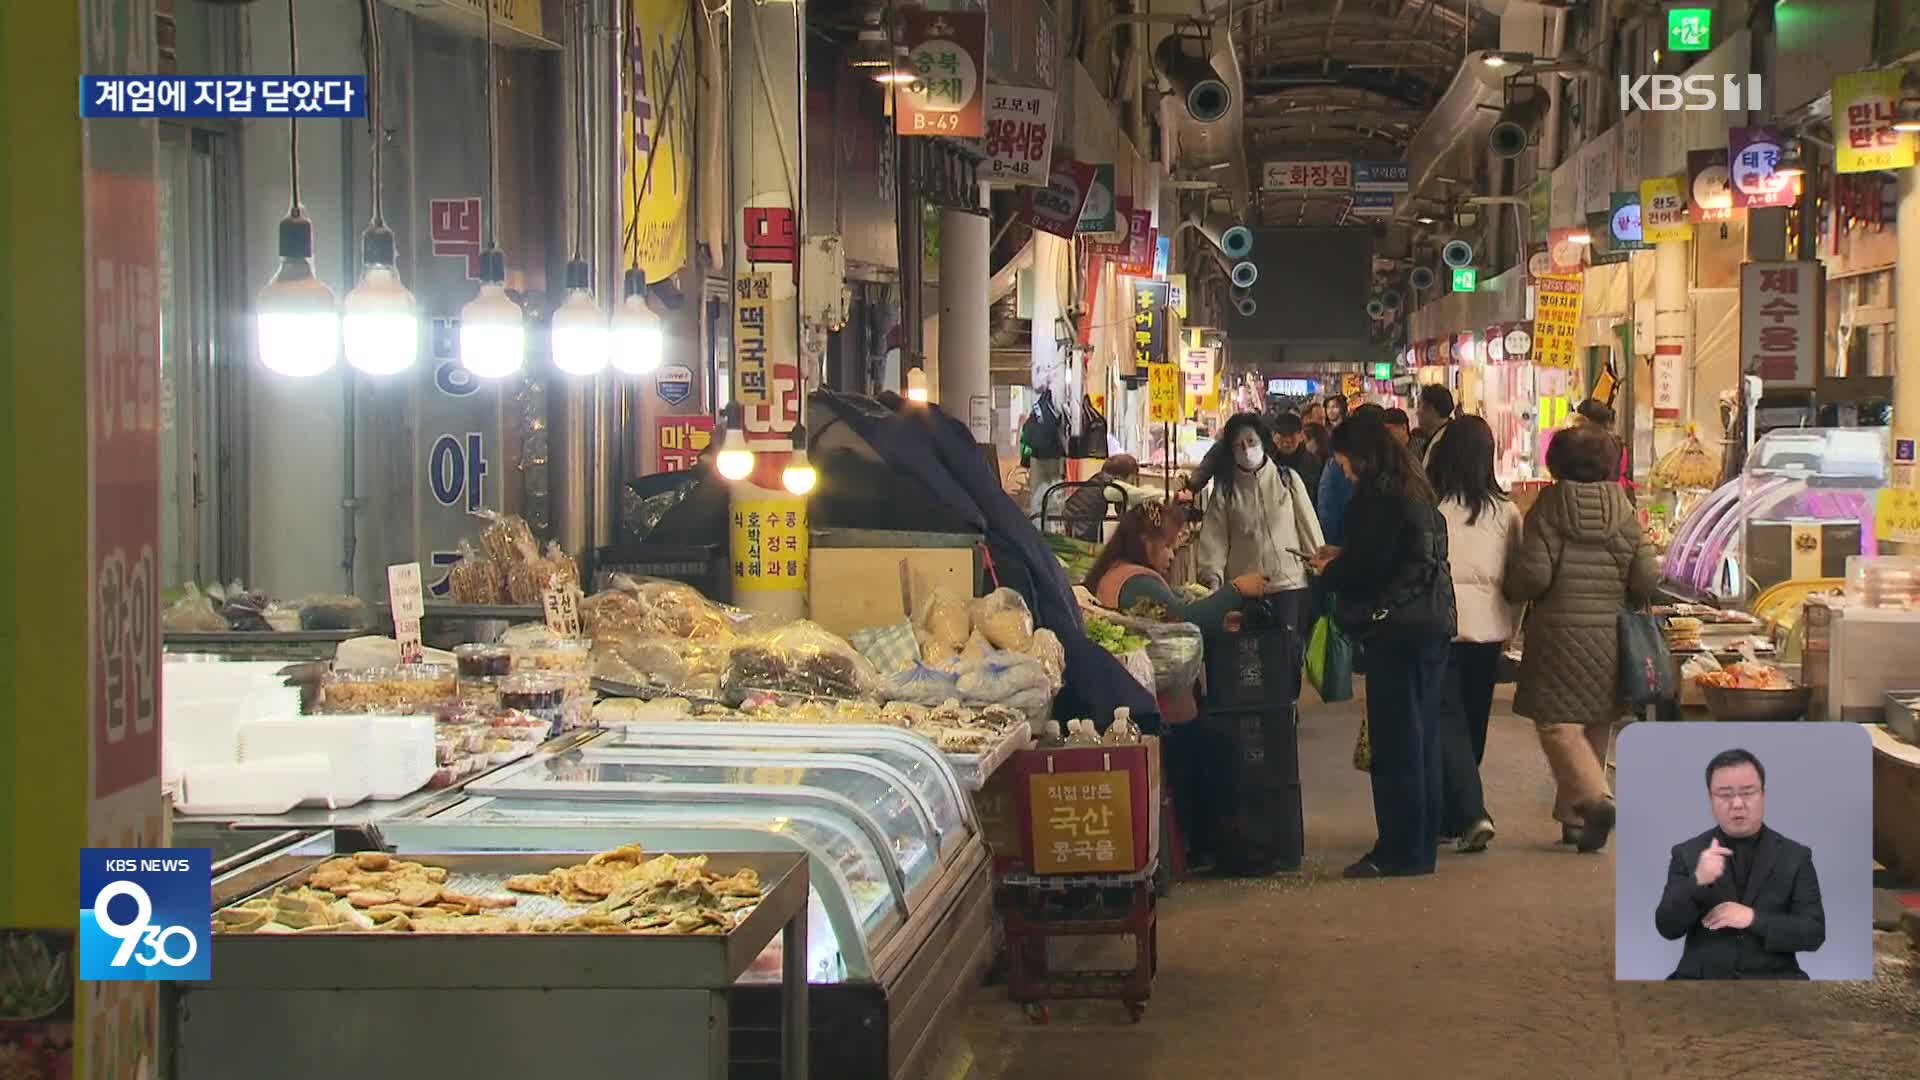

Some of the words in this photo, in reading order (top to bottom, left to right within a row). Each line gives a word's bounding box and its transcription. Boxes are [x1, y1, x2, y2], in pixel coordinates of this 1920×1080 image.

[914, 51, 960, 74] 충북
[913, 112, 960, 131] B-49
[987, 119, 1047, 160] 정육식당
[992, 160, 1030, 174] B-48
[1289, 165, 1348, 187] 화장실
[737, 277, 769, 299] 햅쌀
[739, 305, 768, 401] 떡국떡
[767, 511, 781, 577] 수정과
[1048, 784, 1078, 800] 직접
[1081, 783, 1113, 800] 만든
[1049, 804, 1114, 837] 국산
[1051, 839, 1116, 862] 콩국물
